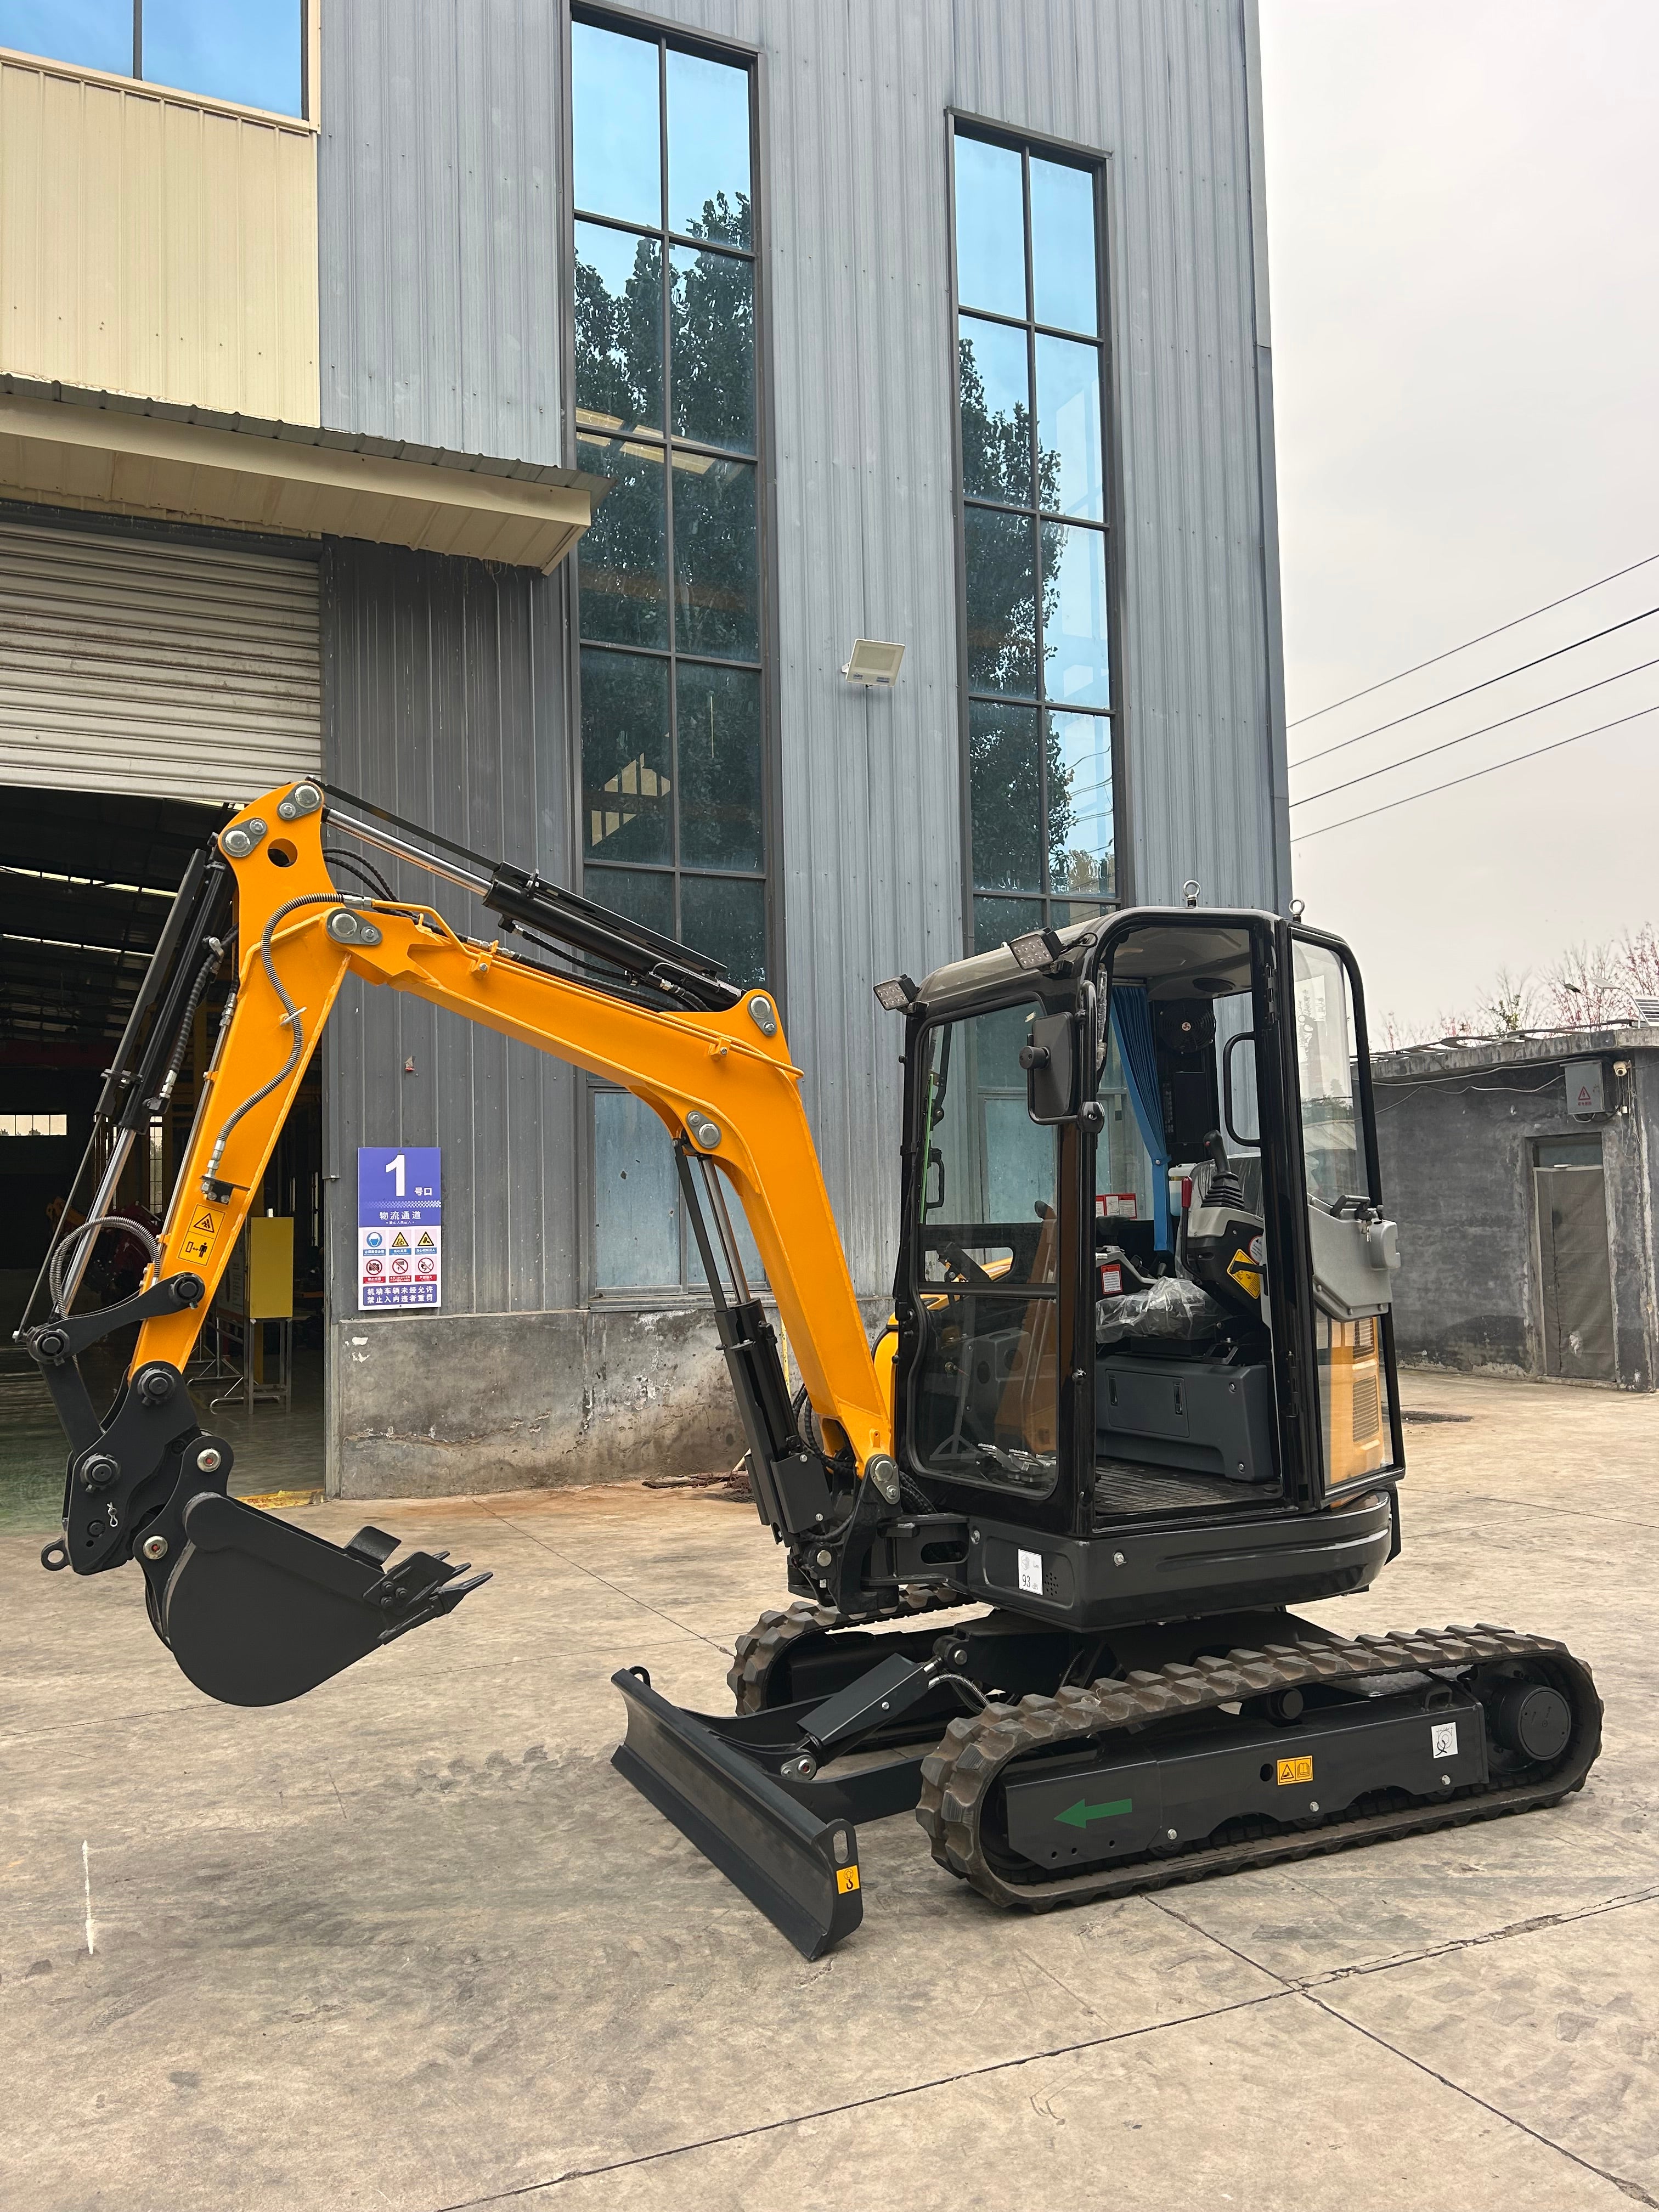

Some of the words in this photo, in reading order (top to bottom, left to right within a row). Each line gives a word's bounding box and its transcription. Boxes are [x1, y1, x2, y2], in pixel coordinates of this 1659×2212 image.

[386, 1154, 405, 1197] 1
[414, 1187, 432, 1196] 号口
[379, 1210, 421, 1220] 物流通道
[367, 1285, 433, 1295] 机动车辆未经允许
[367, 1294, 433, 1304] 禁止入内违者重罚
[1022, 1574, 1031, 1588] 93
